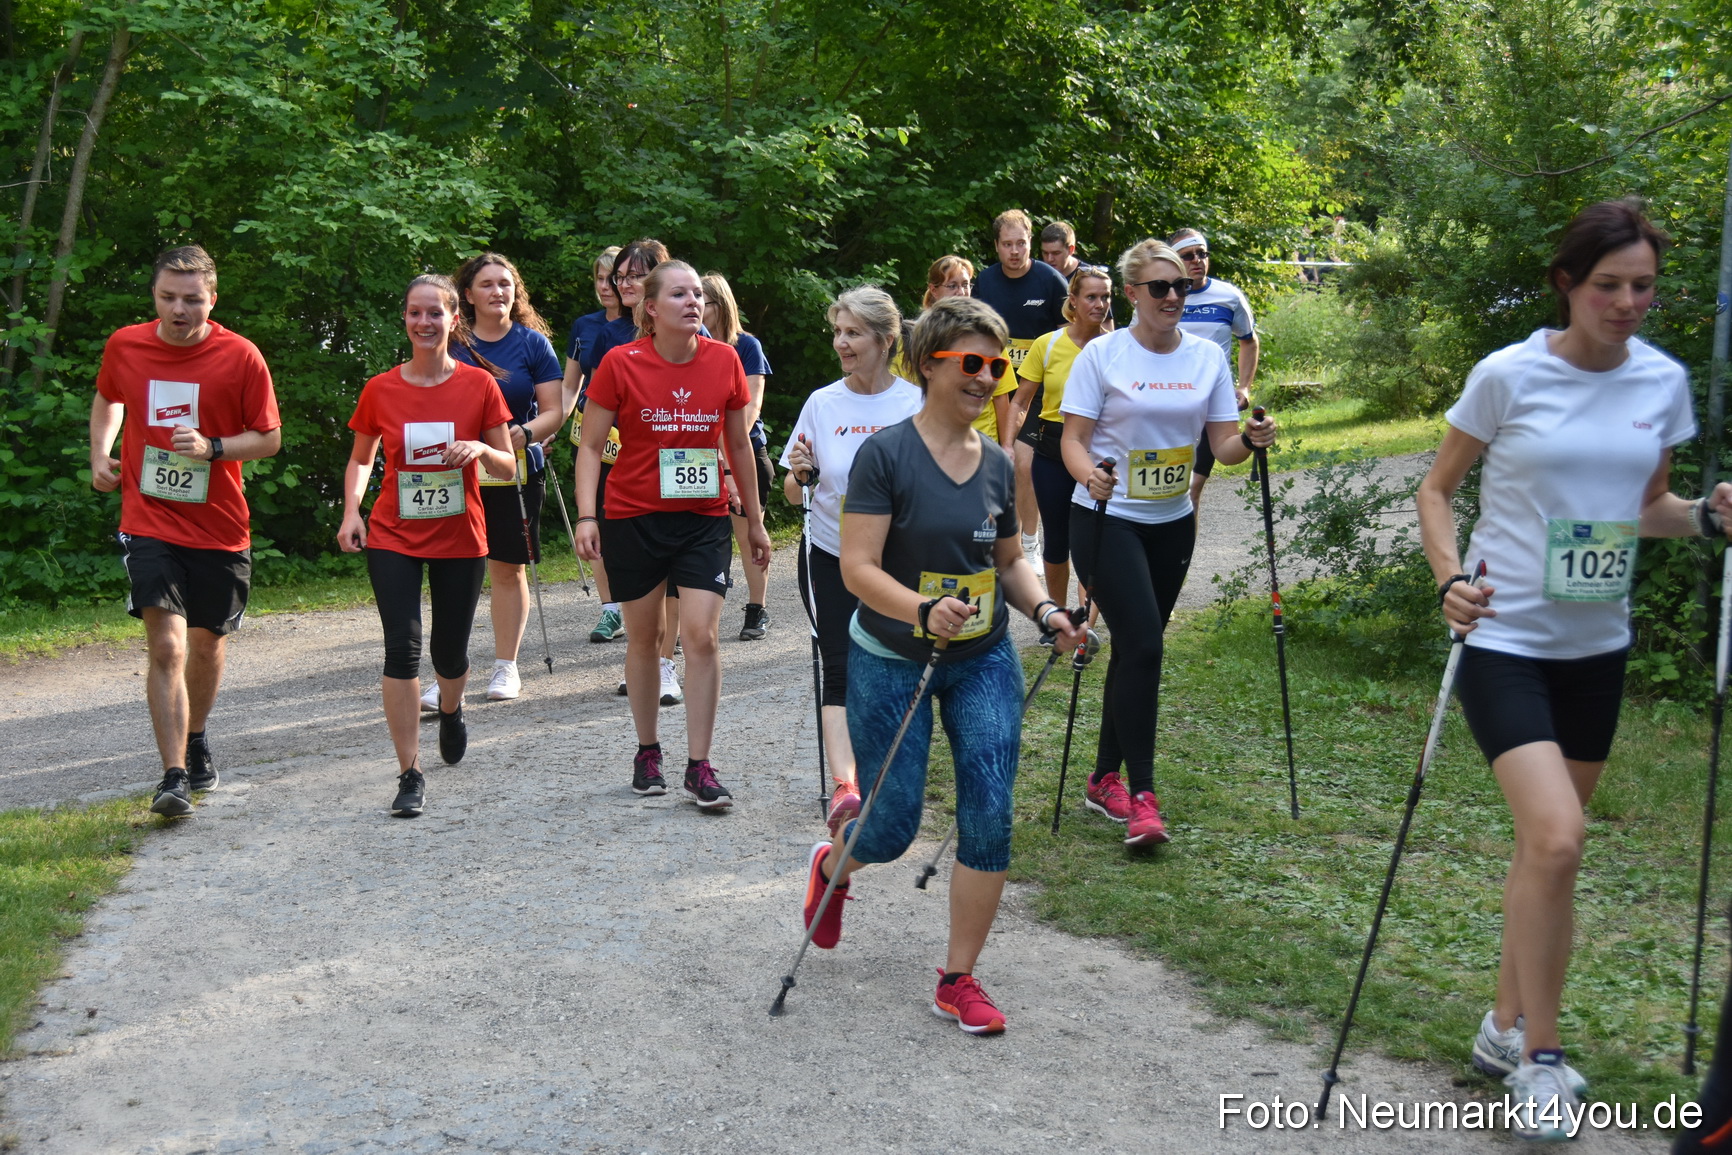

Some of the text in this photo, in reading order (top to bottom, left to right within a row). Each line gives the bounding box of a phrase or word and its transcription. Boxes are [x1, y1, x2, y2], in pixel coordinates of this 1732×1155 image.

[1148, 382, 1197, 390] KLEBL
[165, 408, 182, 416] DEHN
[640, 407, 719, 423] Echtes Handwerk
[652, 424, 710, 432] IMMER FRISCH
[851, 425, 887, 434] KLE
[422, 447, 438, 455] DEHN
[605, 440, 618, 457] 06
[155, 466, 194, 489] 502
[675, 466, 708, 484] 585
[1137, 464, 1185, 486] 1162
[412, 488, 450, 506] 473
[1560, 549, 1628, 579] 1025
[969, 596, 982, 619] 4
